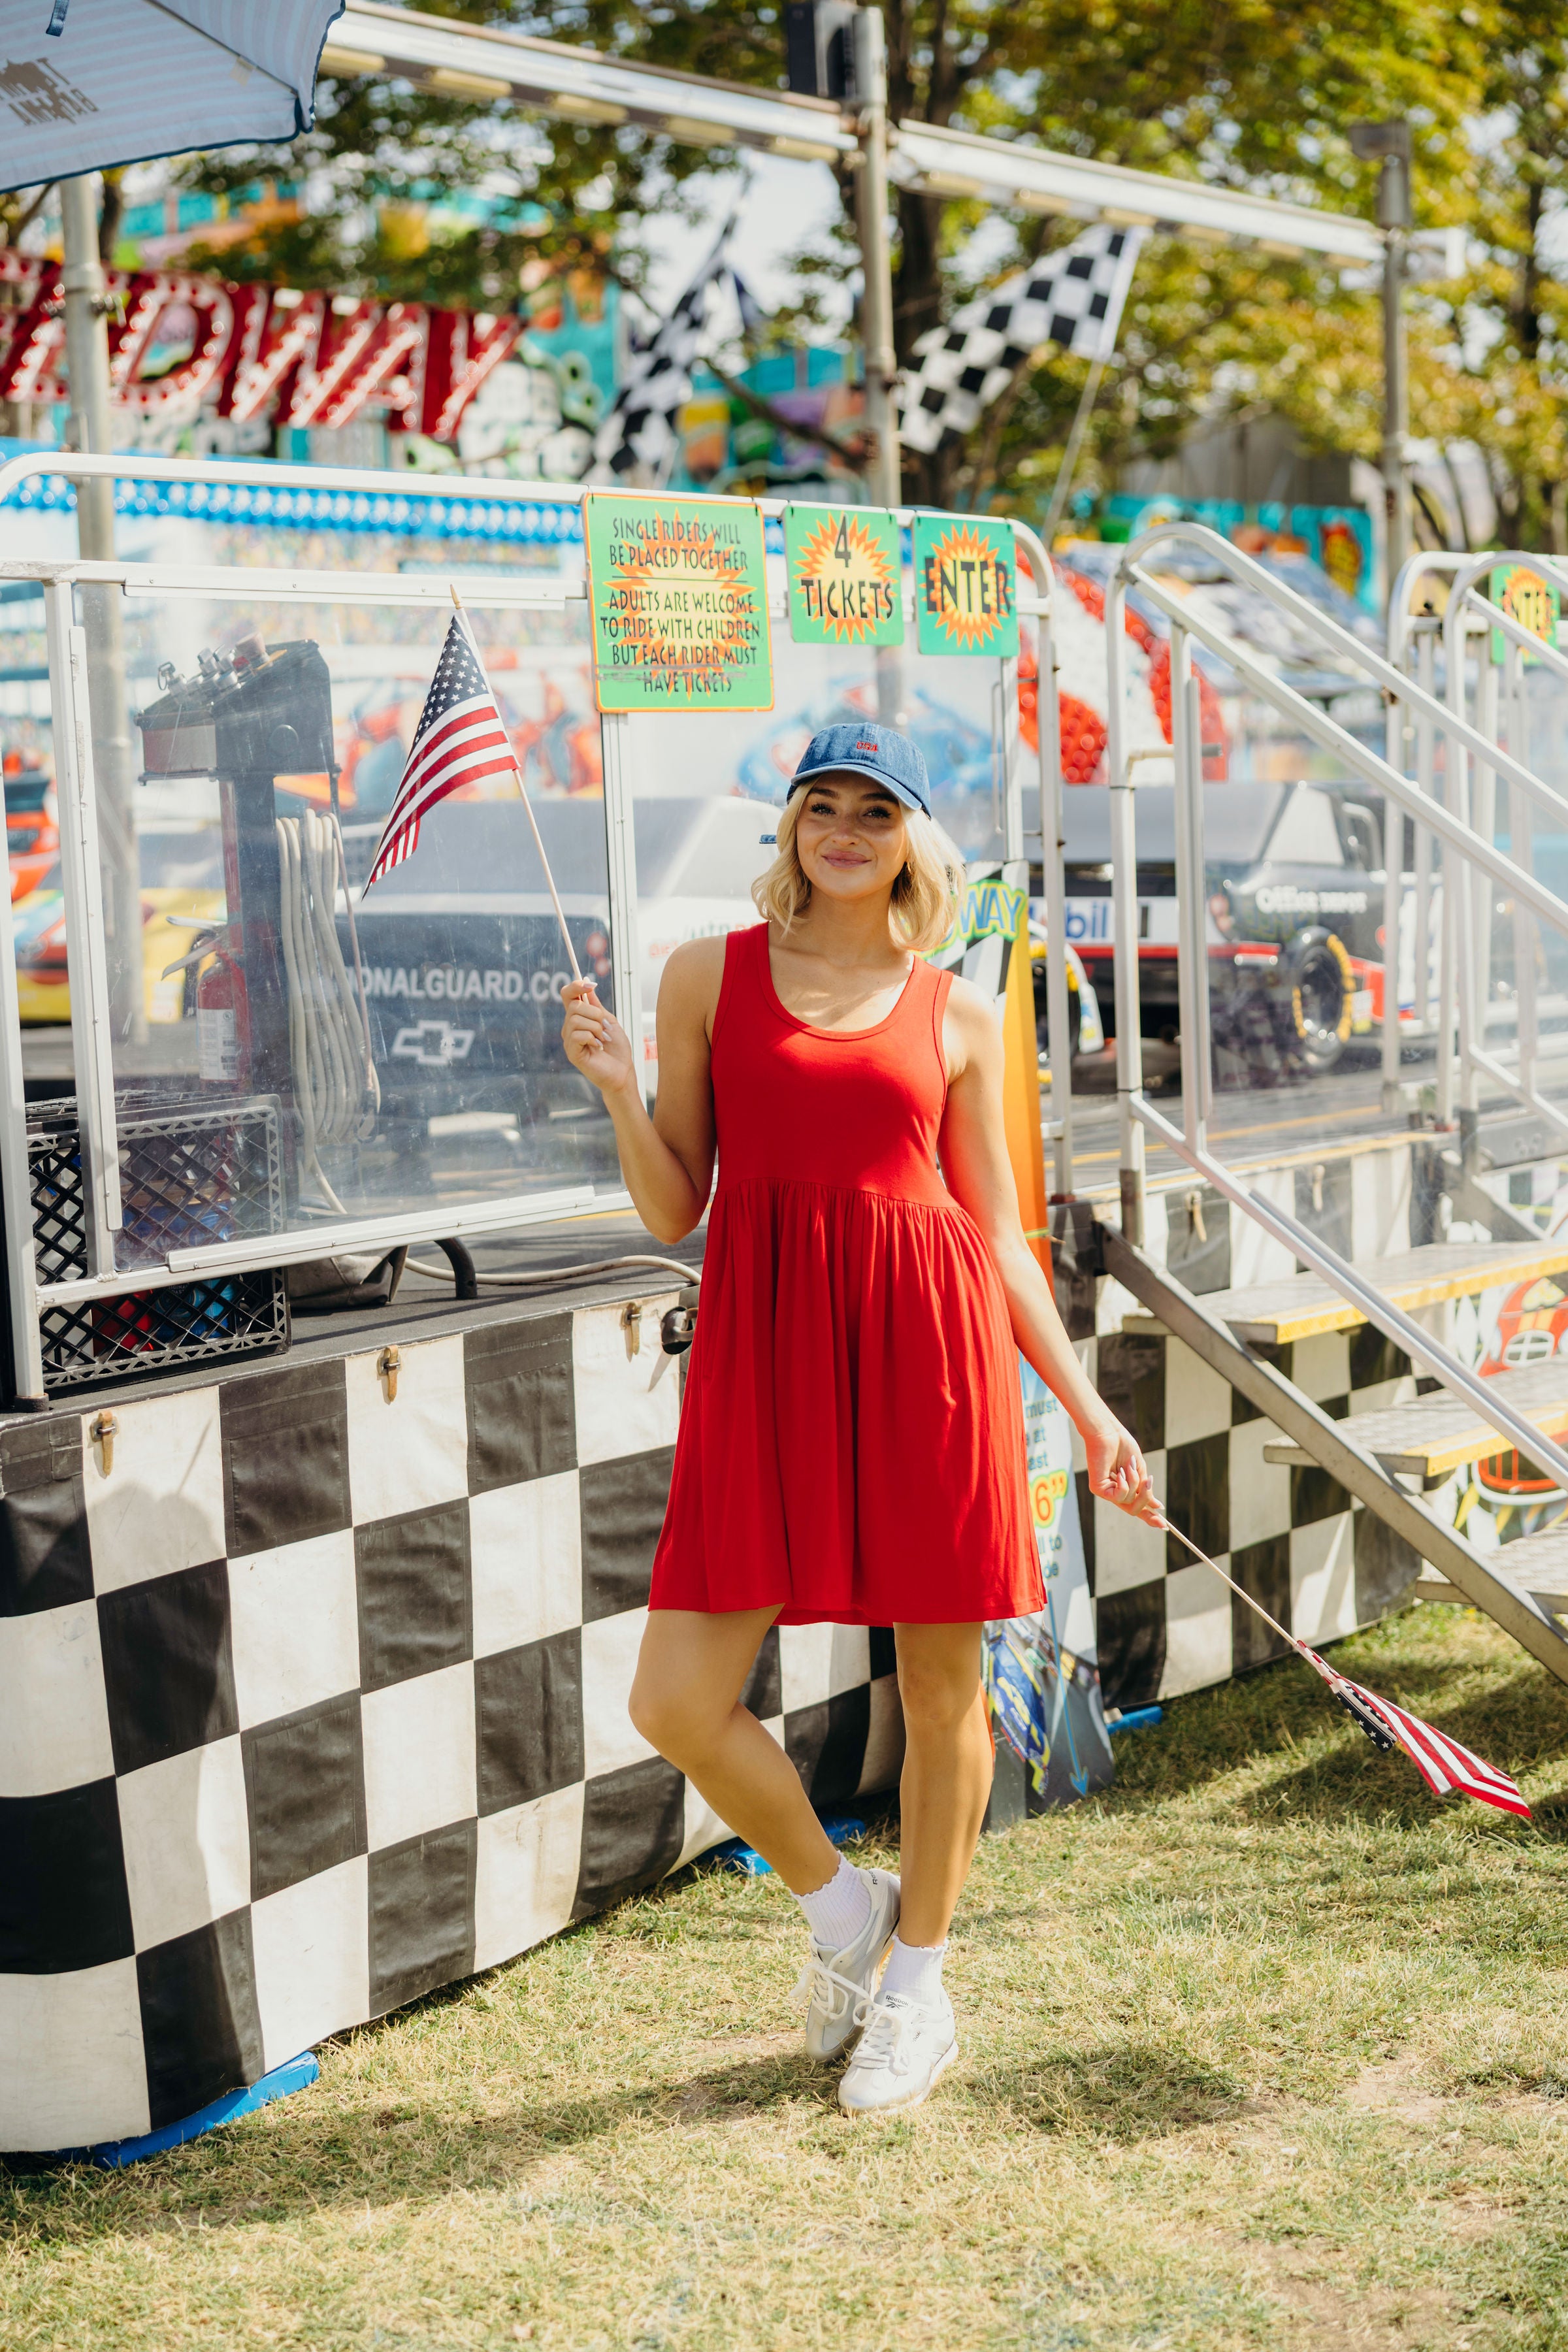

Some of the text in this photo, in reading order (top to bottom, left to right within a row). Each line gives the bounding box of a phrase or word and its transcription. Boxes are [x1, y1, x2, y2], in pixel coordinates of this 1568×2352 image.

[613, 517, 741, 544] SINGLE RIDERS WILL
[834, 515, 851, 568] 4
[610, 544, 748, 571] BE PLACED TOGETHER
[925, 557, 1011, 614] ENTER
[609, 590, 753, 613] ADULTS ARE WELCOME
[801, 579, 893, 619] TICKETS
[600, 616, 619, 638] TO
[624, 617, 654, 638] RIDE
[658, 618, 693, 639] WITH
[613, 645, 757, 665] BUT EACH RIDER MUST
[644, 672, 732, 693] HAVE TICKETS
[857, 741, 878, 752] USA
[947, 884, 1024, 941] WAY
[1025, 1397, 1058, 1418] must
[1034, 1426, 1046, 1443] at
[1028, 1452, 1049, 1471] ast
[1049, 1535, 1062, 1551] to
[1043, 1559, 1059, 1579] de
[885, 1995, 909, 2006] Reebok
